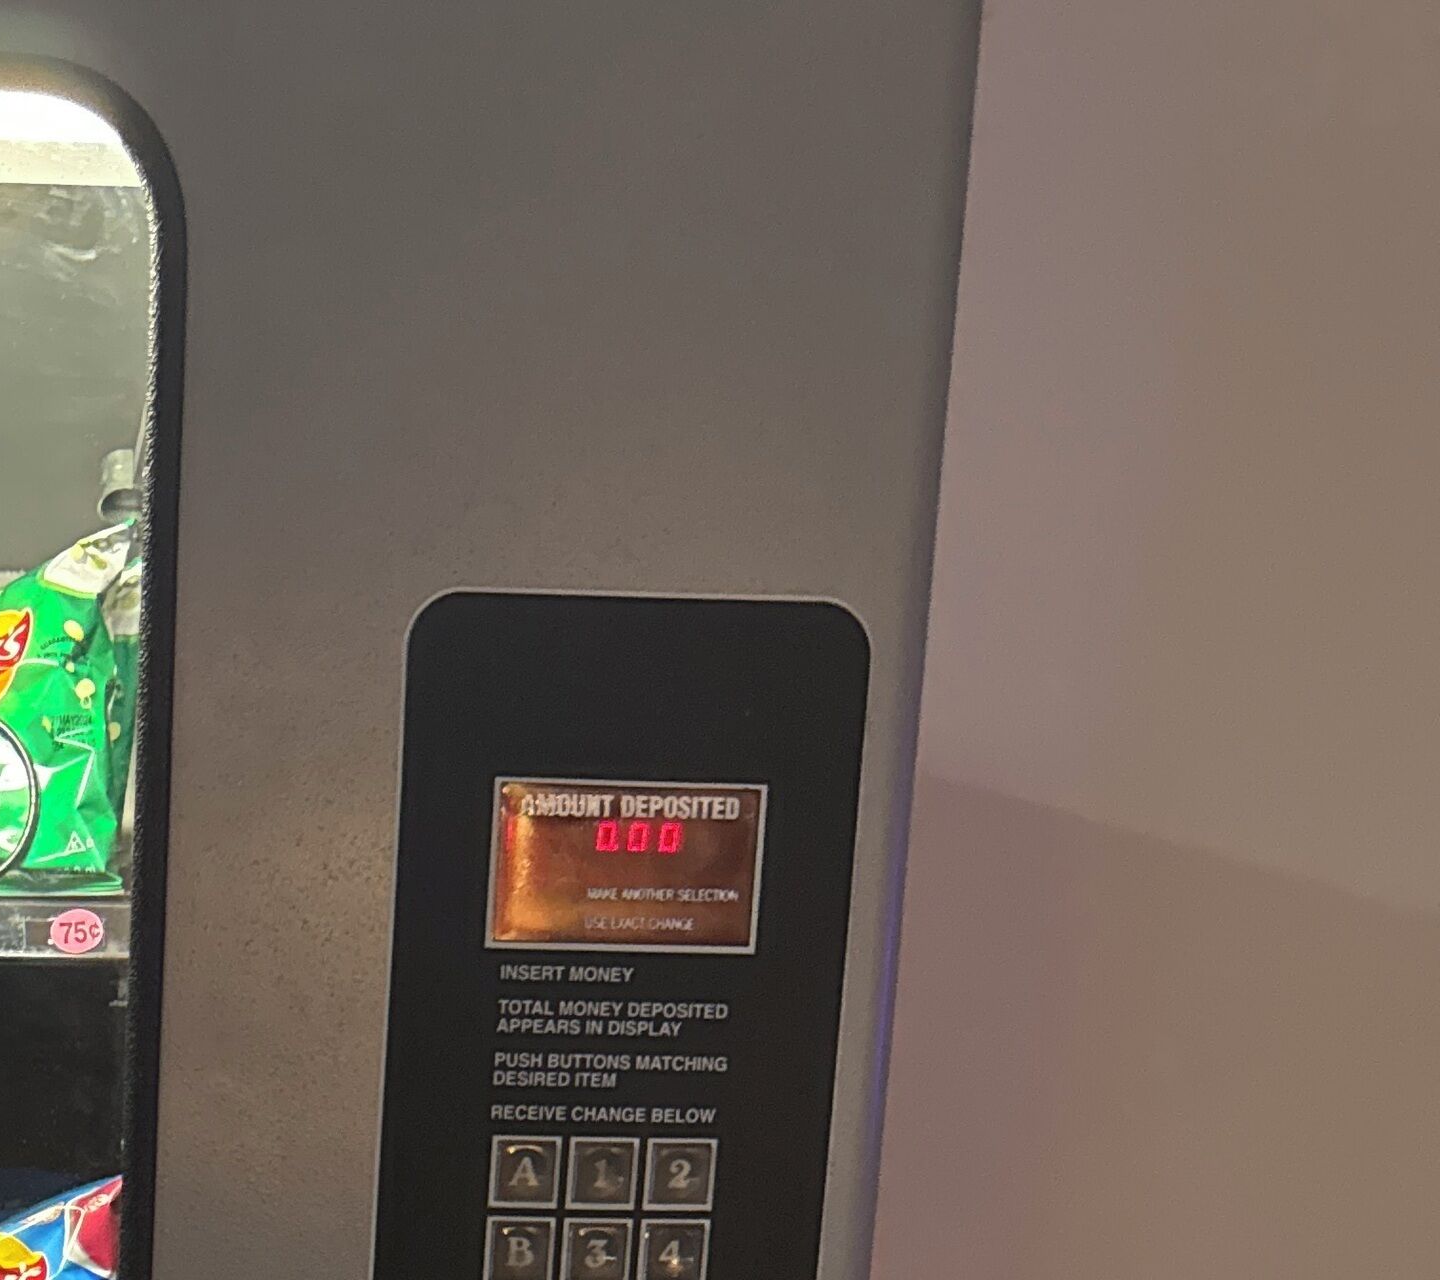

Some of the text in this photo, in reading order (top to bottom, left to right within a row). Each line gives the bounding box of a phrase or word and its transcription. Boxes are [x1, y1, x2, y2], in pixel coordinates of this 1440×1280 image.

[619, 795, 741, 820] DEPOSITED
[58, 920, 101, 944] 75¢
[500, 965, 634, 983] INSERT MONEY
[498, 999, 729, 1019] TOTAL MONEY DEPOSITED
[496, 1019, 682, 1036] APPEARS IN DISPLAY
[494, 1052, 729, 1072] PUSH BUTTONS MATCHING
[492, 1071, 617, 1088] DESIRED ITEM
[490, 1104, 716, 1124] RECEIVE CHANGE BELOW
[509, 1157, 540, 1186] A
[593, 1159, 610, 1188] 1
[667, 1159, 692, 1189] 2
[505, 1237, 534, 1267] B
[585, 1239, 607, 1268] 3
[659, 1240, 681, 1268] 4
